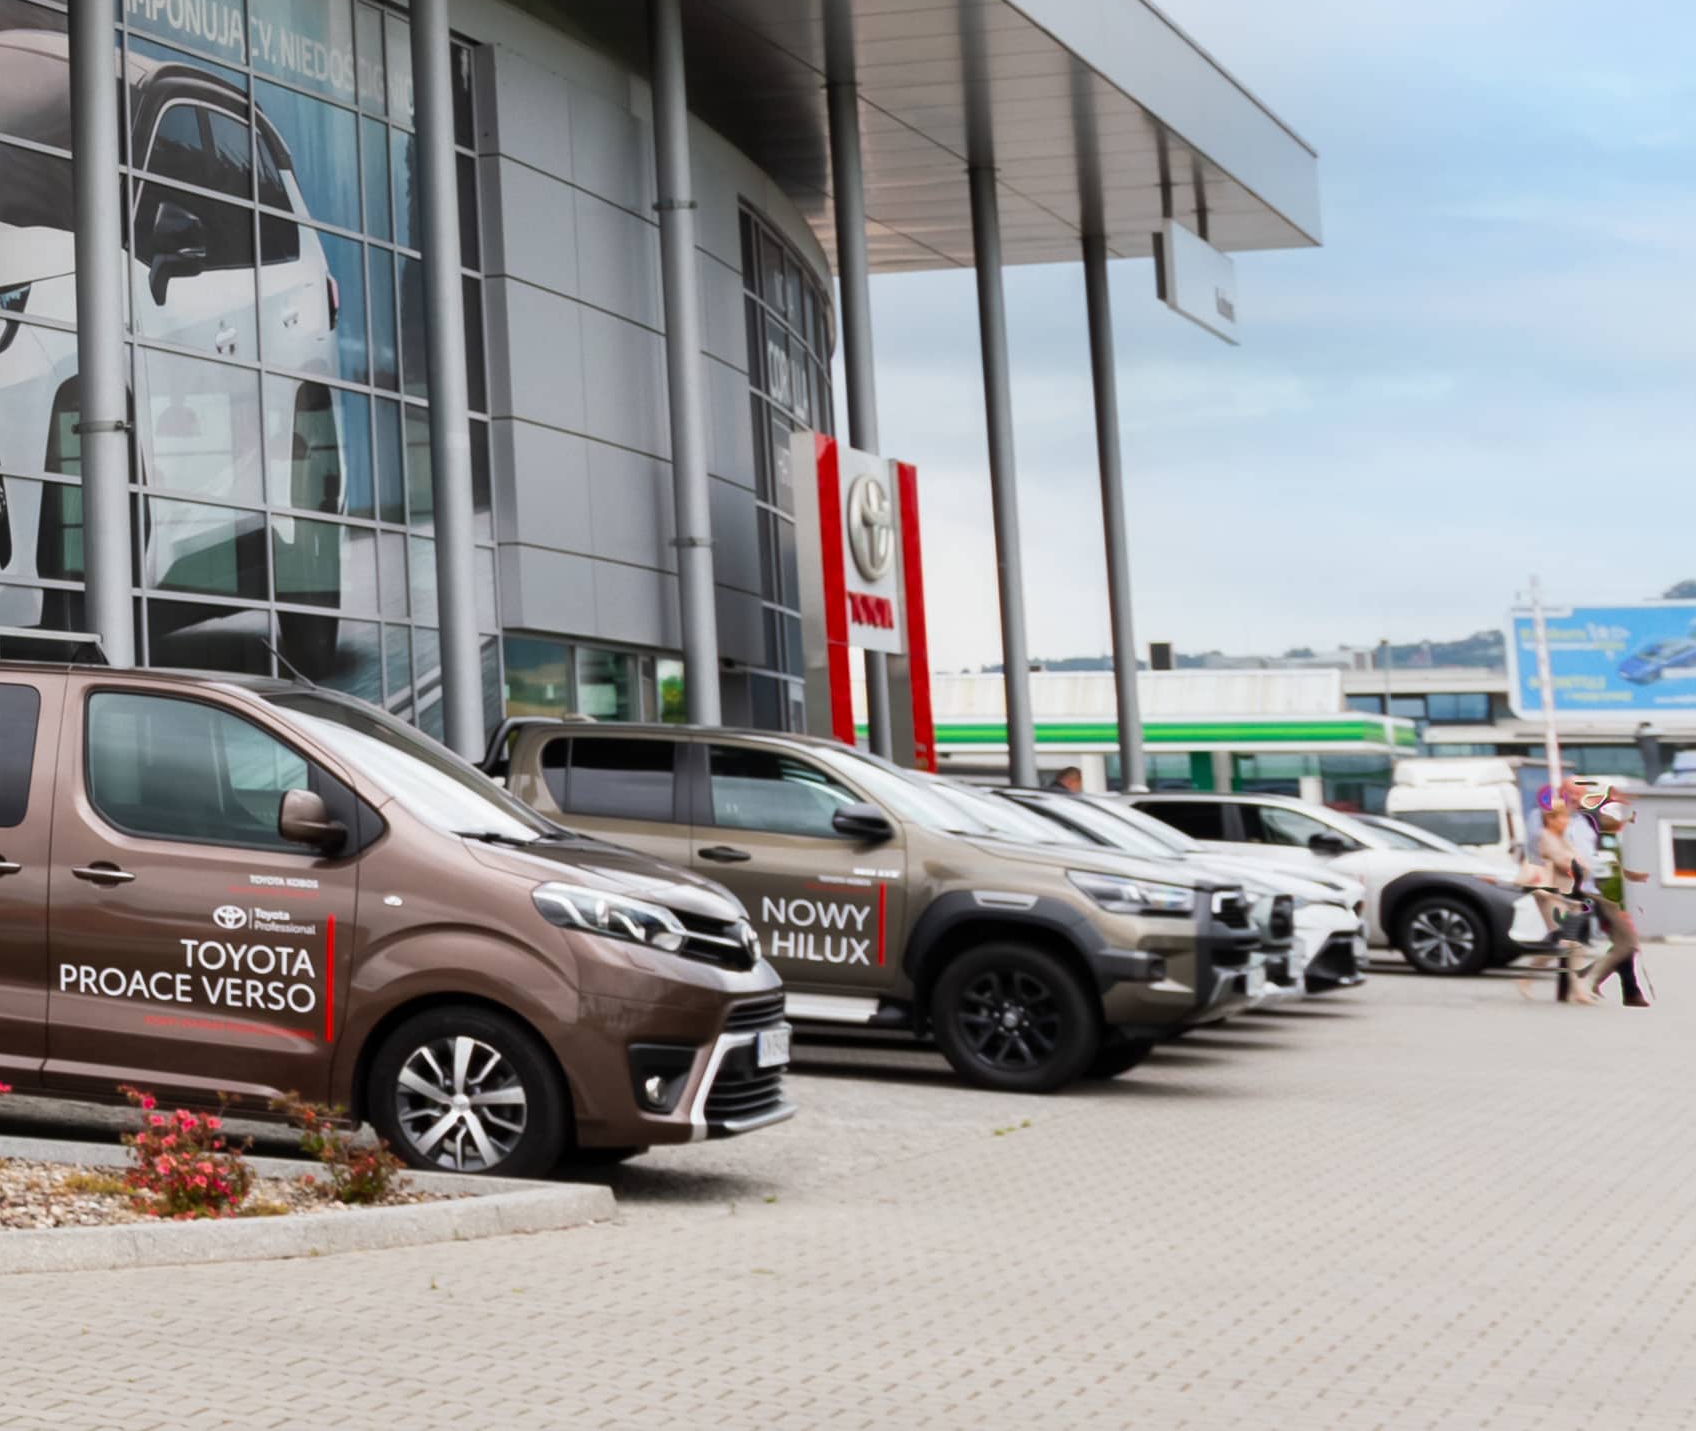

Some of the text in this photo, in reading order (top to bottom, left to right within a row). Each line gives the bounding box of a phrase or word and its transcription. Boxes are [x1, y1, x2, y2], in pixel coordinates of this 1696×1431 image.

[255, 908, 290, 922] Toyota
[255, 919, 316, 936] Professional
[762, 896, 871, 932] NOWY
[180, 939, 316, 979] TOYOTA
[771, 930, 871, 966] HILUX
[60, 963, 316, 1014] PROACE VERSO
